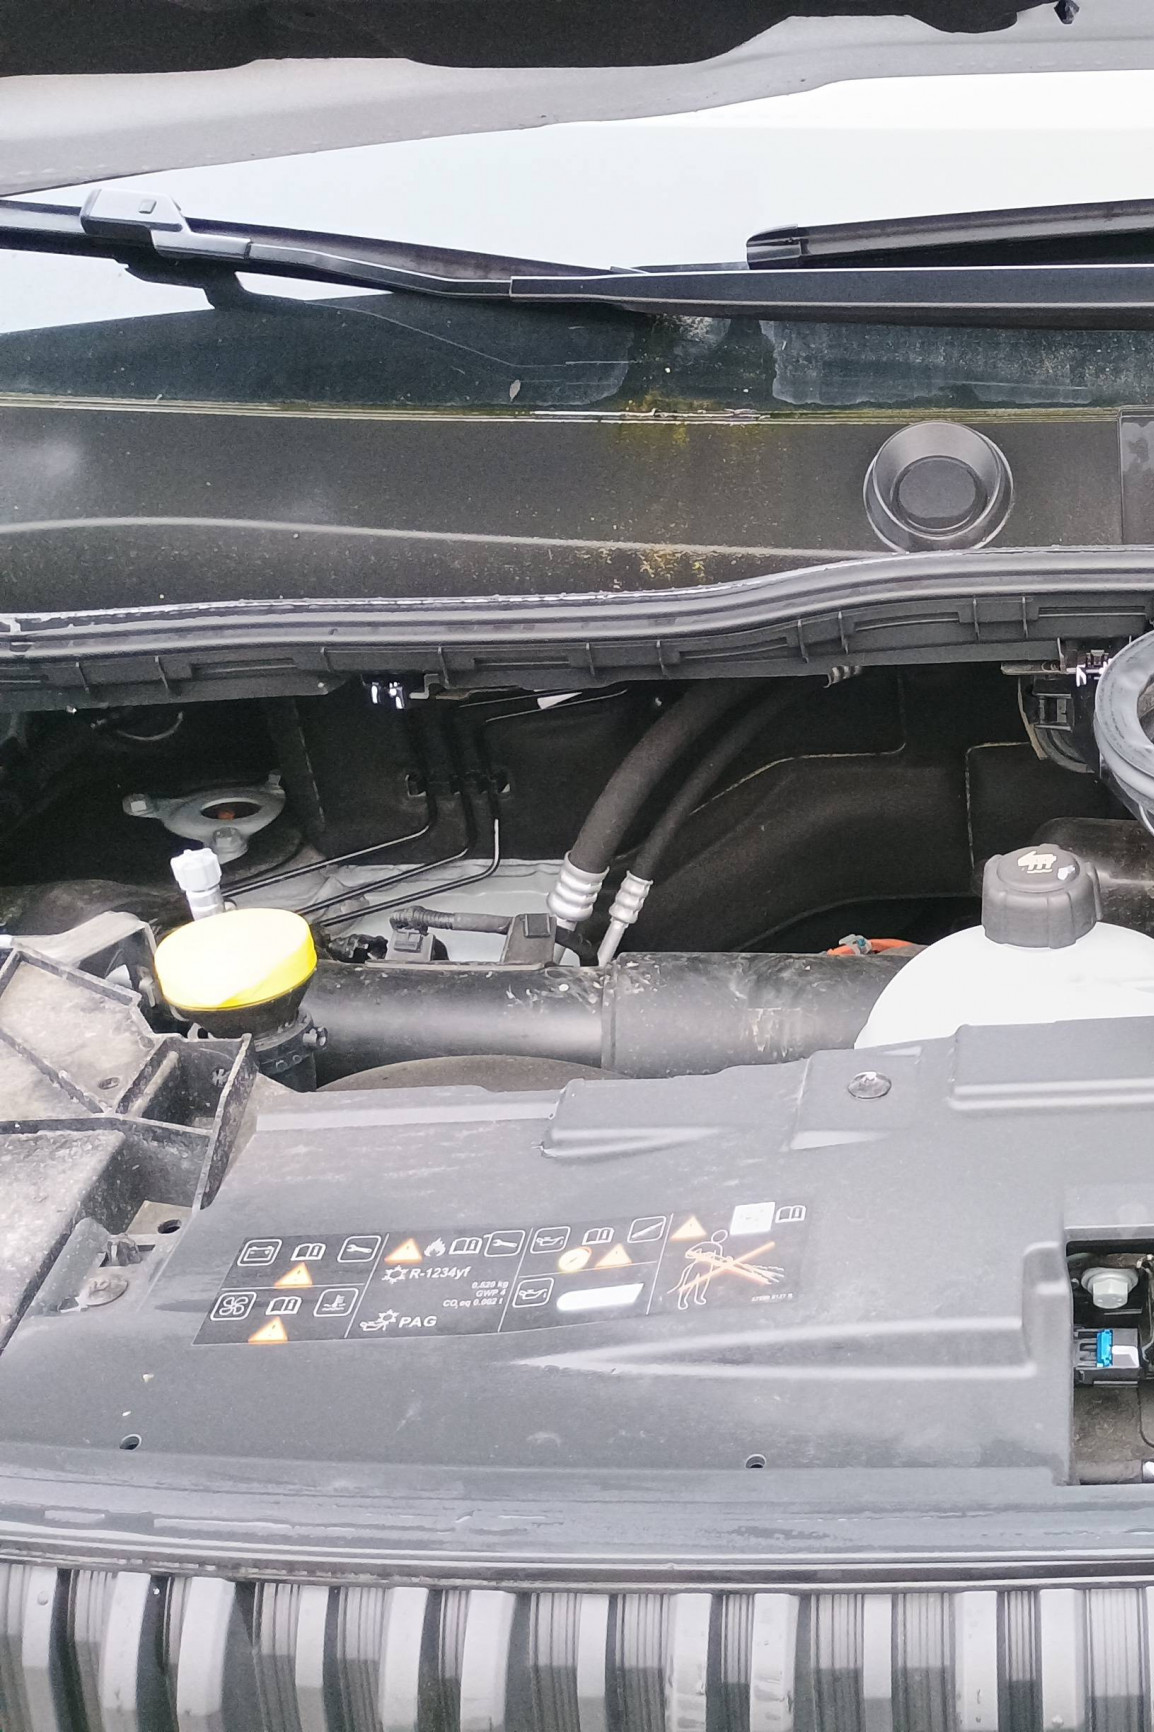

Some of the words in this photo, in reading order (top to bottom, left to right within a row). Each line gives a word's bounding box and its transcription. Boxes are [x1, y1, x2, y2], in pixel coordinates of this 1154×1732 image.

[409, 1266, 471, 1279] R-1234yf
[497, 1281, 509, 1289] kg
[398, 1315, 438, 1328] PAG
